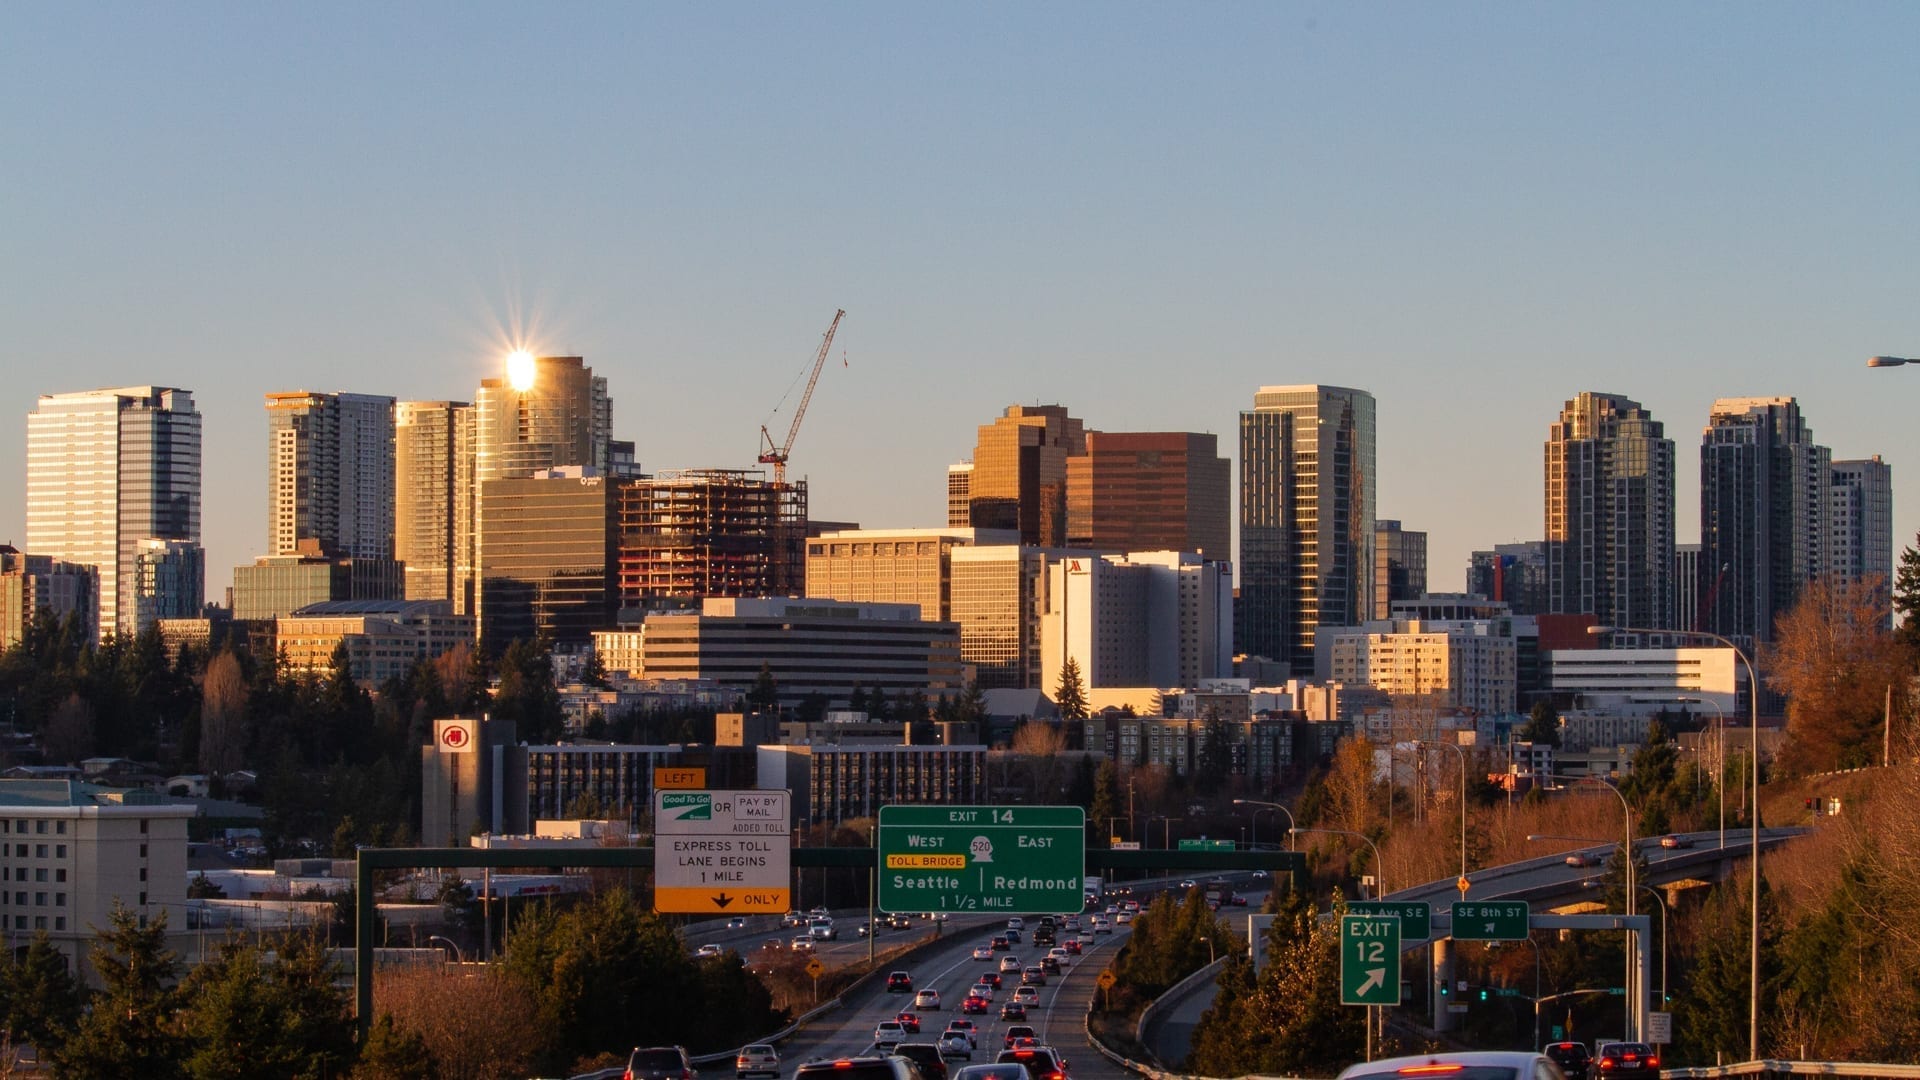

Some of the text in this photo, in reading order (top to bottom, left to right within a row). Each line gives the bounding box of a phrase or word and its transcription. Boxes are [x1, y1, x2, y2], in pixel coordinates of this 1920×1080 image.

[664, 773, 696, 784] LEFT
[663, 795, 711, 803] Good To Go!
[740, 798, 777, 806] PAY BY
[714, 802, 732, 812] OR
[747, 808, 770, 816] MAIL
[949, 809, 1014, 824] EXIT 14
[732, 823, 785, 832] ADDED TOLL
[674, 841, 771, 851] EXPRESS TOLL
[907, 835, 945, 848] WEST
[972, 841, 990, 852] 520
[1018, 835, 1053, 848] EAST
[679, 856, 766, 866] LANE BEGINS
[890, 857, 963, 866] TOLL BRIDGE
[701, 871, 744, 883] 1 MILE
[893, 876, 960, 889] Seattle
[994, 876, 1077, 890] Redmond
[744, 894, 780, 905] ONLY
[940, 896, 945, 908] 1
[983, 897, 1014, 907] MILE
[1406, 908, 1424, 917] SE
[1458, 907, 1521, 918] SE 8th ST
[1350, 922, 1391, 937] EXIT
[1356, 941, 1385, 963] 12
